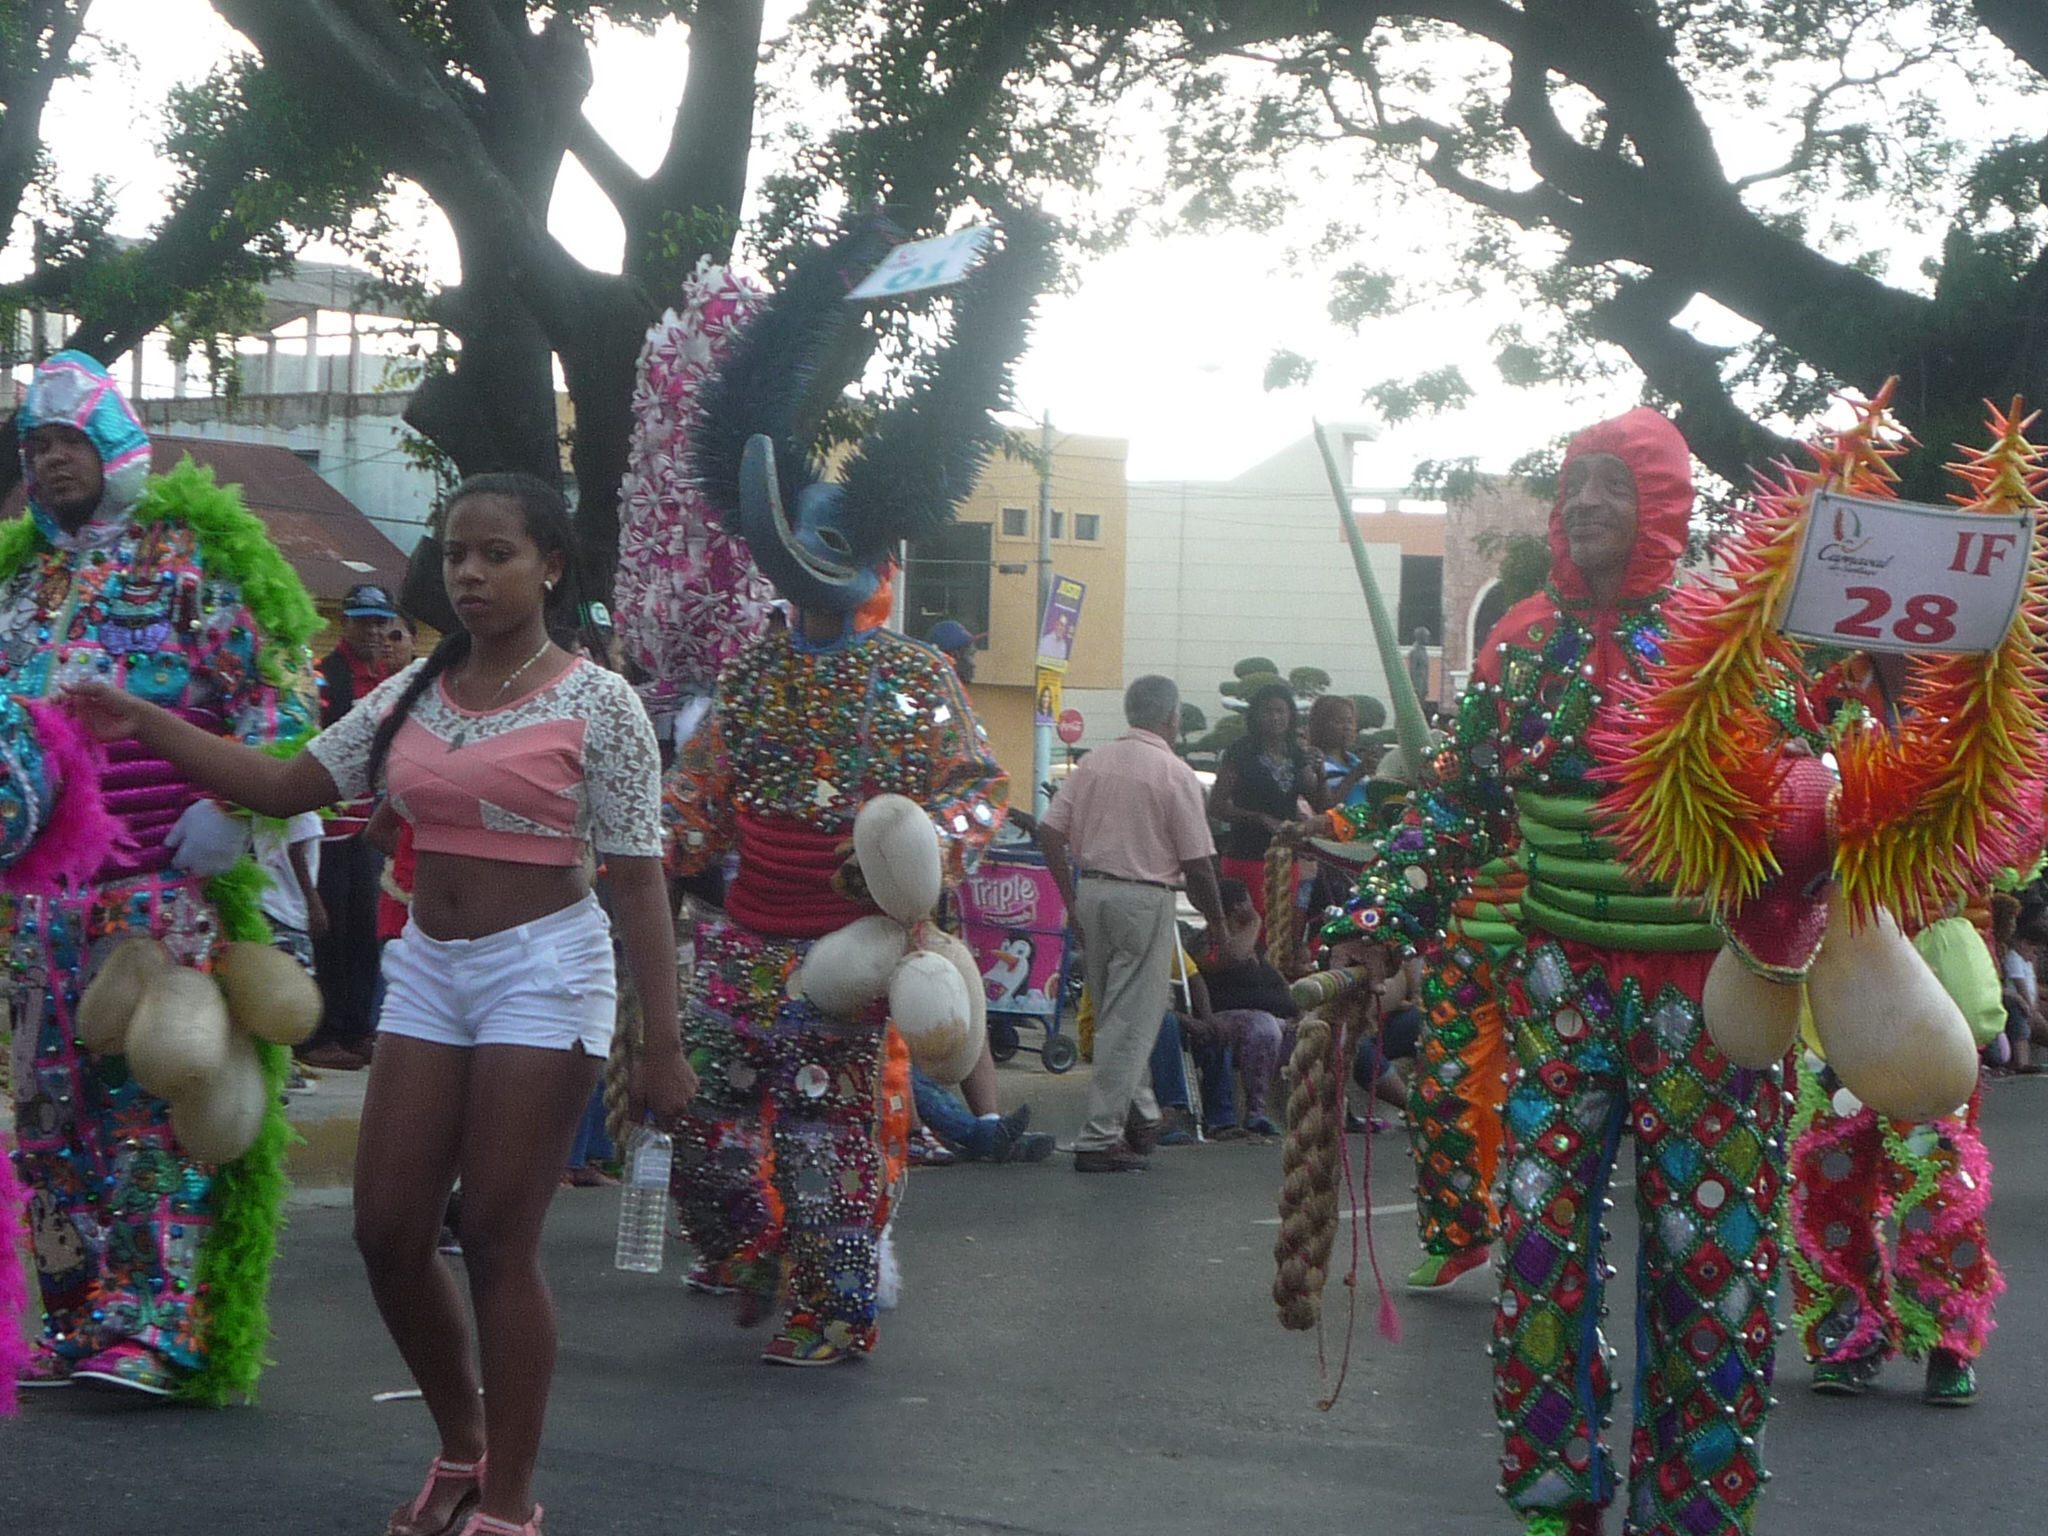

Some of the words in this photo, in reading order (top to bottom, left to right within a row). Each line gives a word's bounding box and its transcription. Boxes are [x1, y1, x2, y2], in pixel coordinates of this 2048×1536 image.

[1948, 531, 2017, 577] IF
[1833, 586, 1958, 644] 28
[969, 875, 1035, 910] Triple
